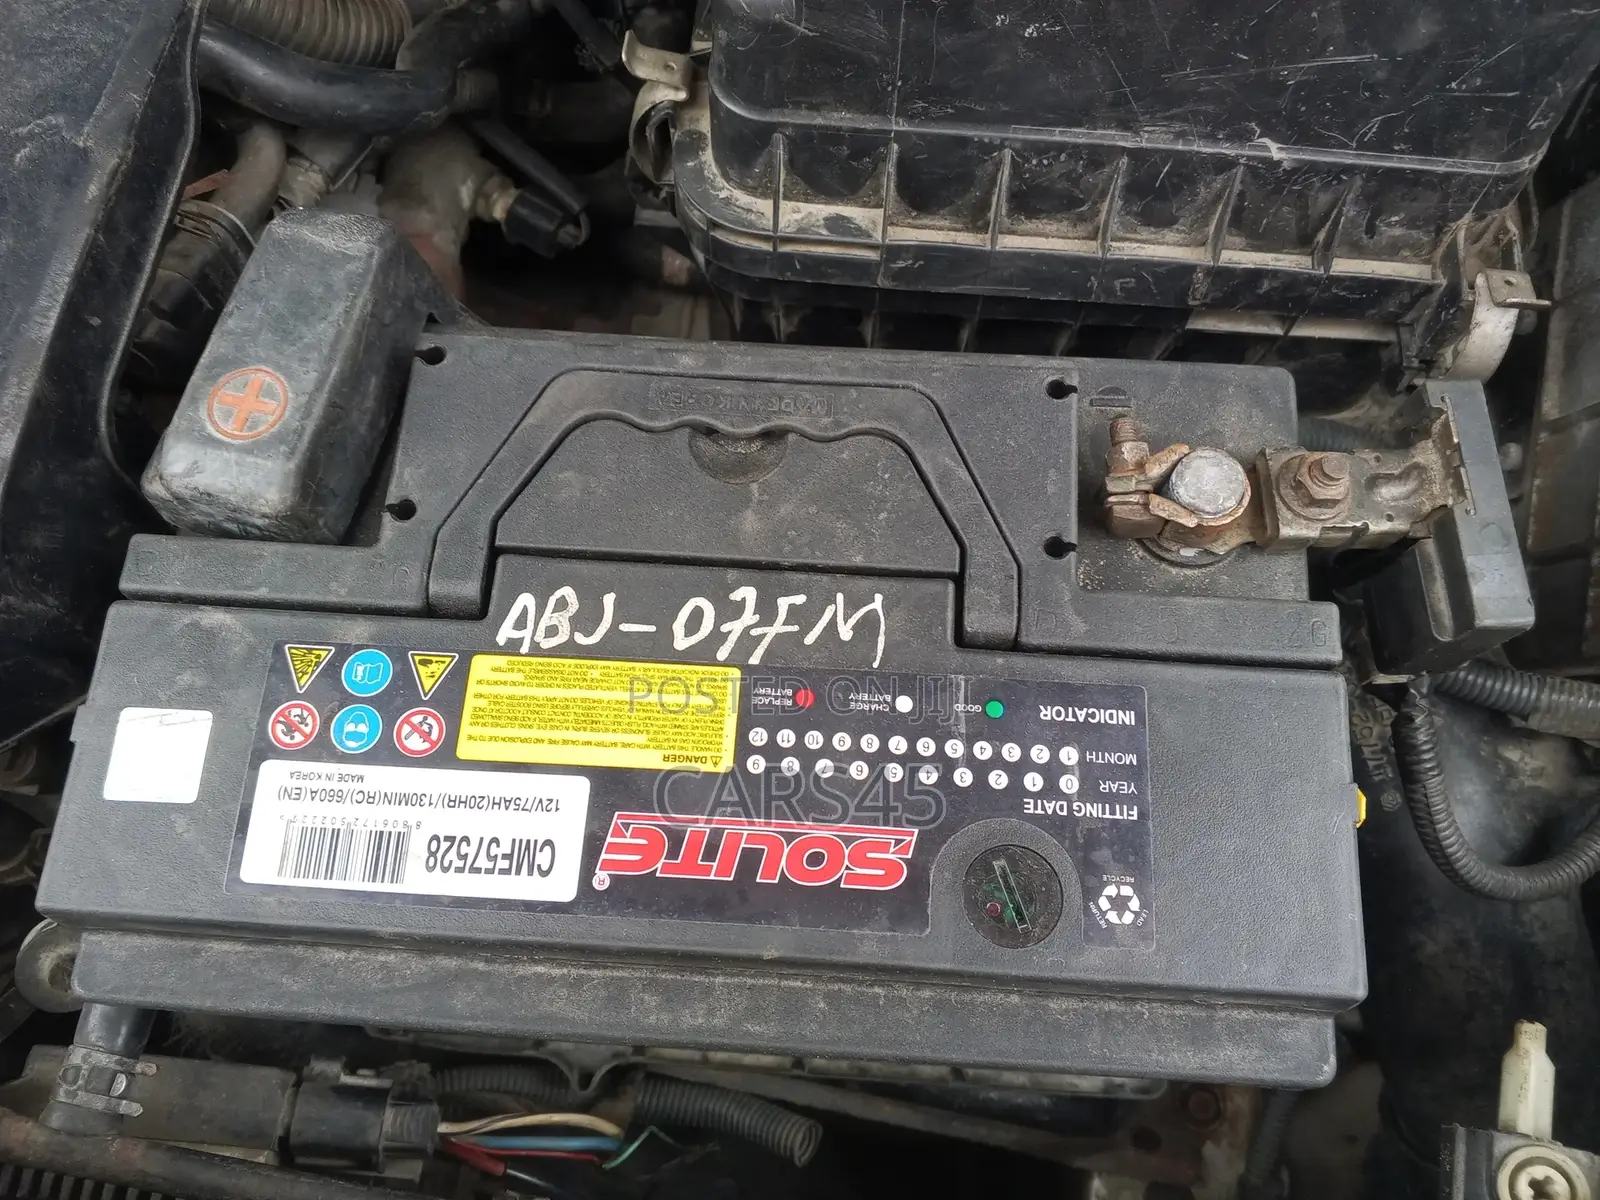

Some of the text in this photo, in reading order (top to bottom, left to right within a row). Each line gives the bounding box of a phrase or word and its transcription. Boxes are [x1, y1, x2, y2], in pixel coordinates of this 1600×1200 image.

[752, 687, 793, 697] BATTERY
[849, 692, 892, 702] BATTERY
[752, 696, 793, 706] REPLACE
[849, 701, 890, 712] CHARGE
[954, 704, 982, 712] GOOD
[1039, 704, 1136, 726] INDICATOR
[662, 754, 708, 764] DANGER
[1086, 750, 1137, 766] MONTH
[289, 770, 365, 784] MADE IN KOREA
[1099, 780, 1138, 794] YEAR
[1023, 798, 1138, 820] FITTING DATE
[424, 834, 556, 878] CMF57528
[596, 811, 919, 891] SOLITE
[1102, 874, 1135, 883] RECYCLE
[1136, 908, 1150, 926] LEAD
